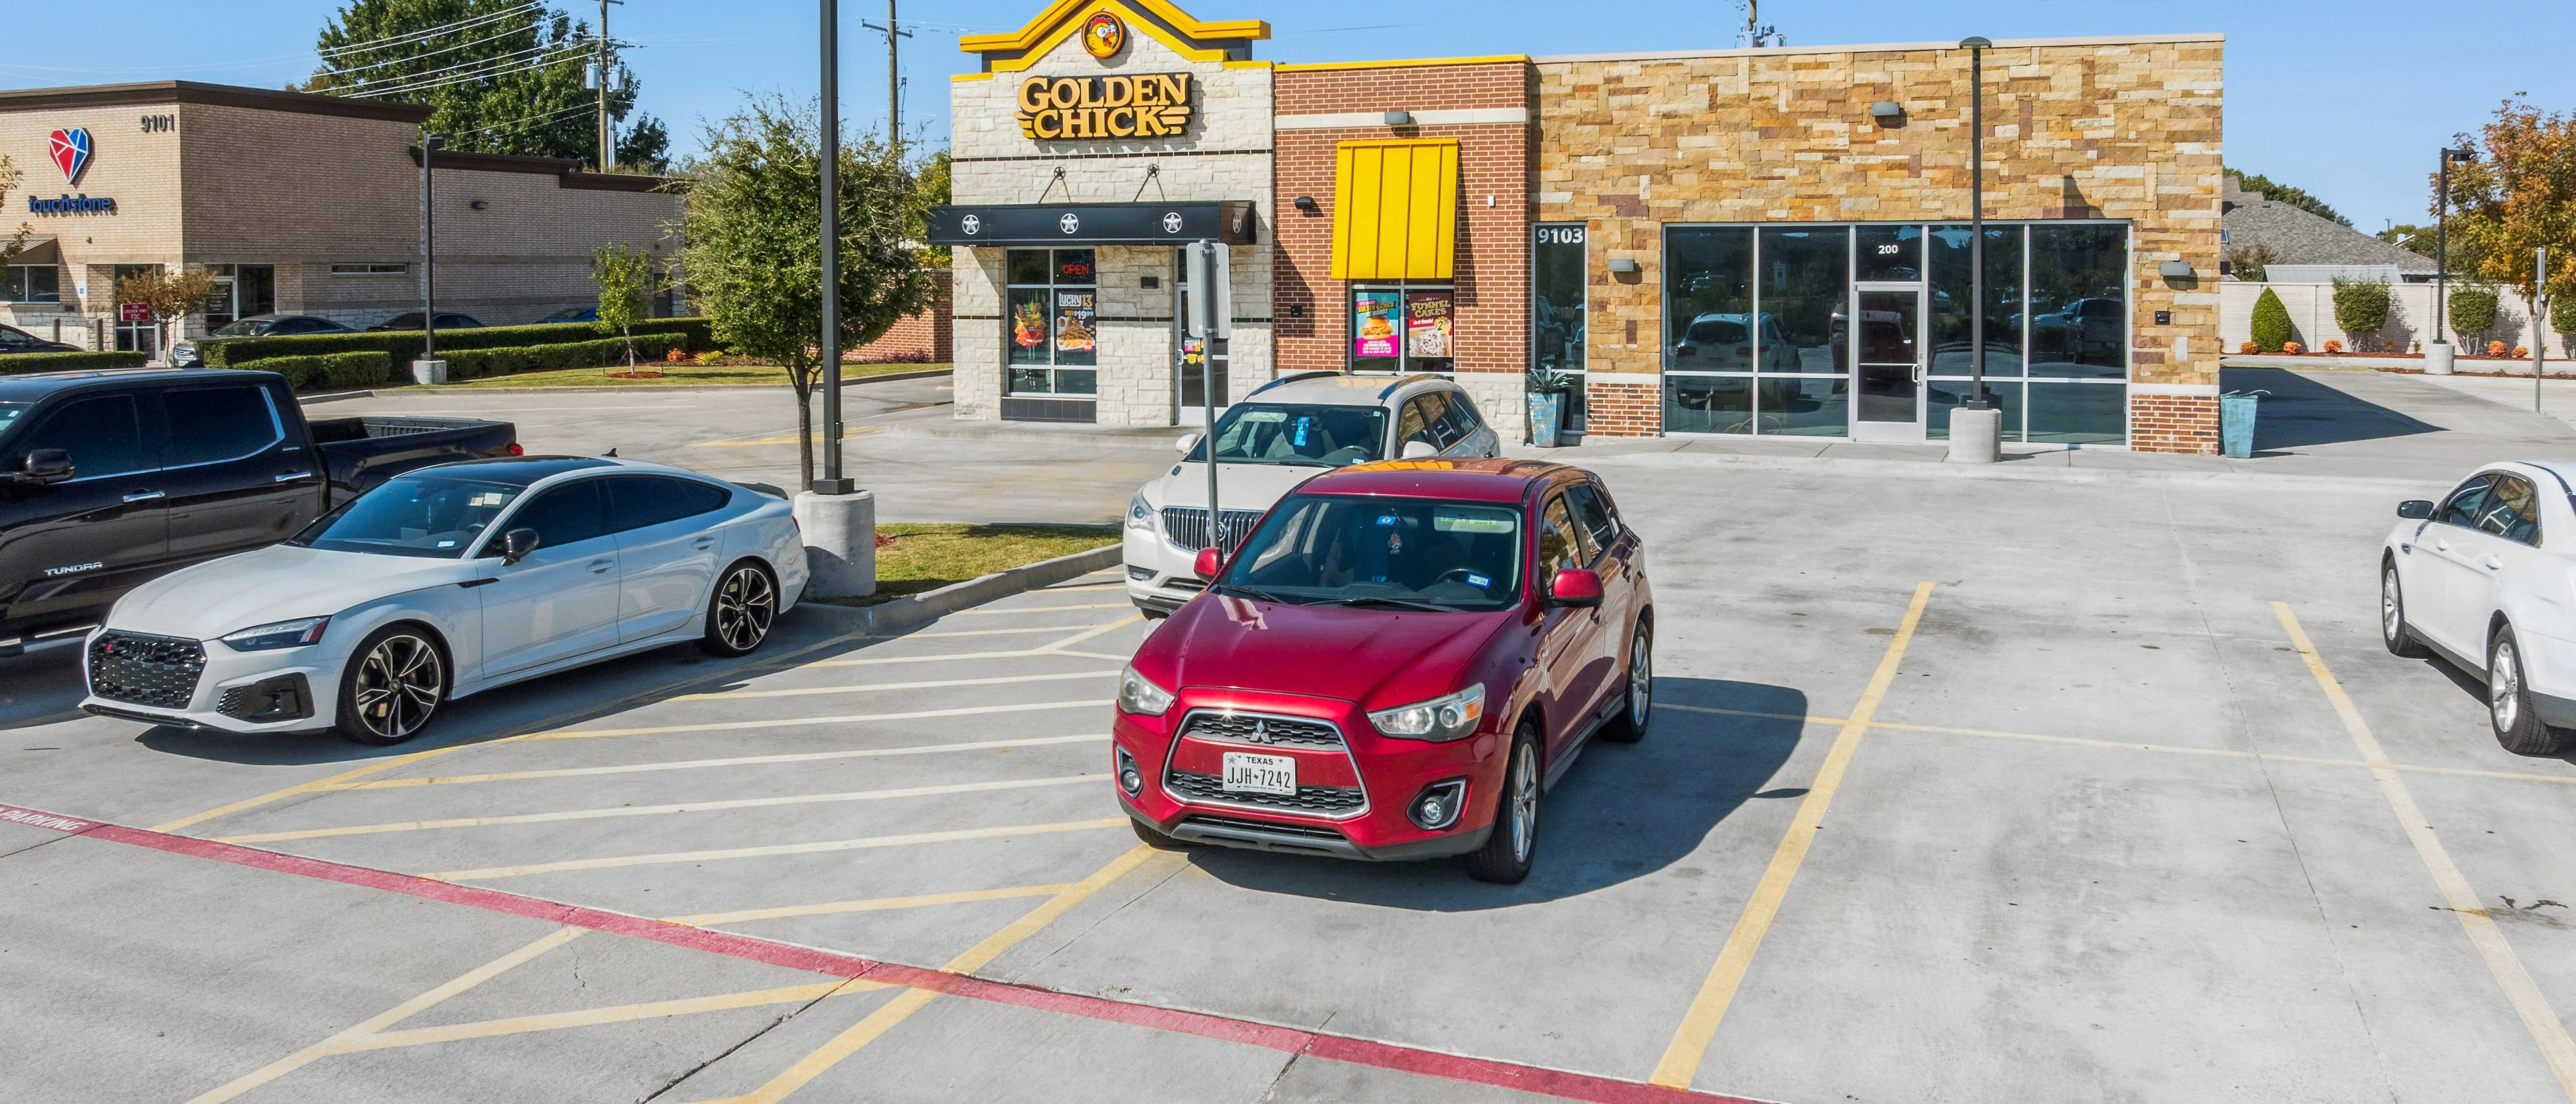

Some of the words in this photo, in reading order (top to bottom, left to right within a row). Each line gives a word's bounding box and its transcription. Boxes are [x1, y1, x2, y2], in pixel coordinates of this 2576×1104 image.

[1018, 73, 1188, 112] GOLDEN
[140, 114, 174, 132] 9101
[1033, 106, 1169, 139] CHICK
[28, 195, 112, 213] touchstone
[1538, 228, 1584, 243] 9103
[1878, 245, 1898, 254] 200
[1062, 264, 1089, 274] OPEN
[1082, 294, 1093, 307] 13
[1411, 300, 1451, 311] FUNNEL
[1358, 304, 1375, 313] GOLDEN
[1415, 307, 1447, 318] CAKES
[43, 562, 103, 576] TUNDRA
[1246, 756, 1273, 765] TEXAS
[2, 810, 88, 831] PARKING
